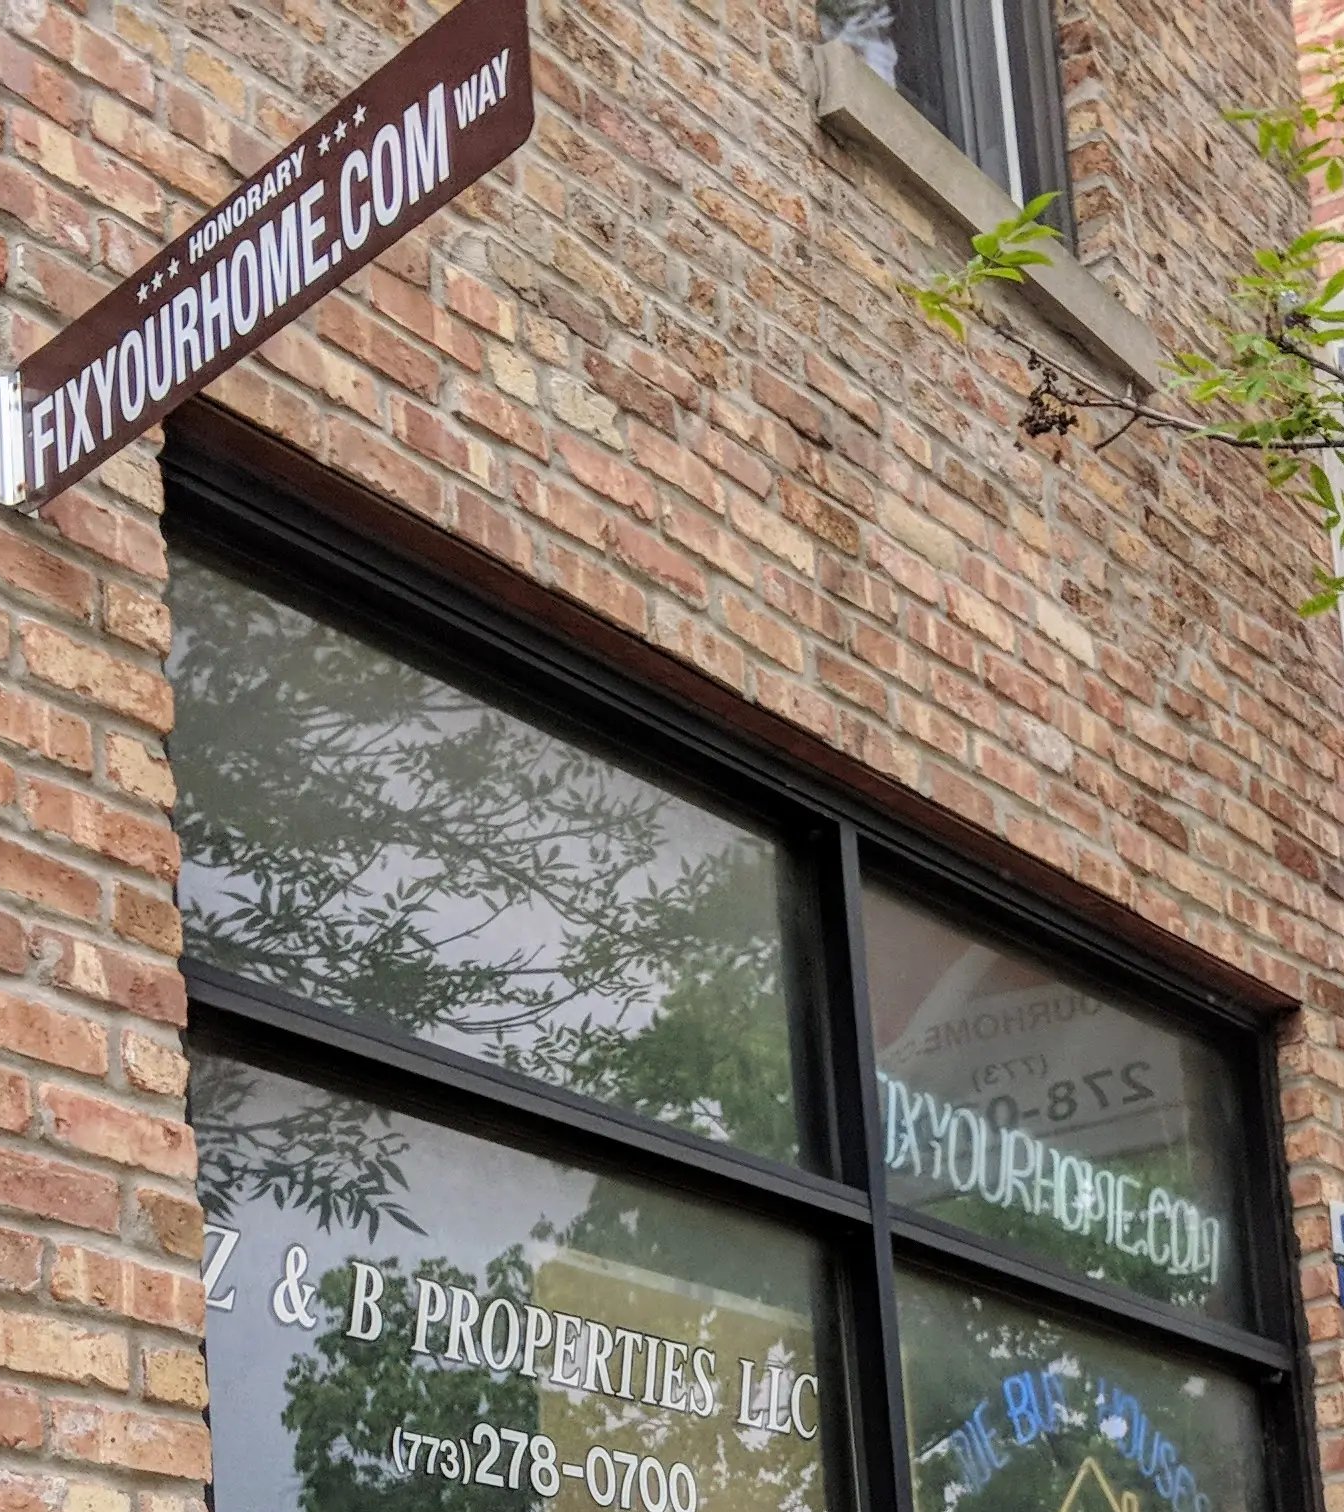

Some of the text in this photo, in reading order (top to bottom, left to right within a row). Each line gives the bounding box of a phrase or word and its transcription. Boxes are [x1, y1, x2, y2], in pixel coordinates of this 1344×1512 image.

[31, 49, 510, 490] FIXYOURHOME.COM WAY
[188, 146, 306, 262] HONORARY
[203, 1223, 819, 1441] Z & B PROPERTIES LLC
